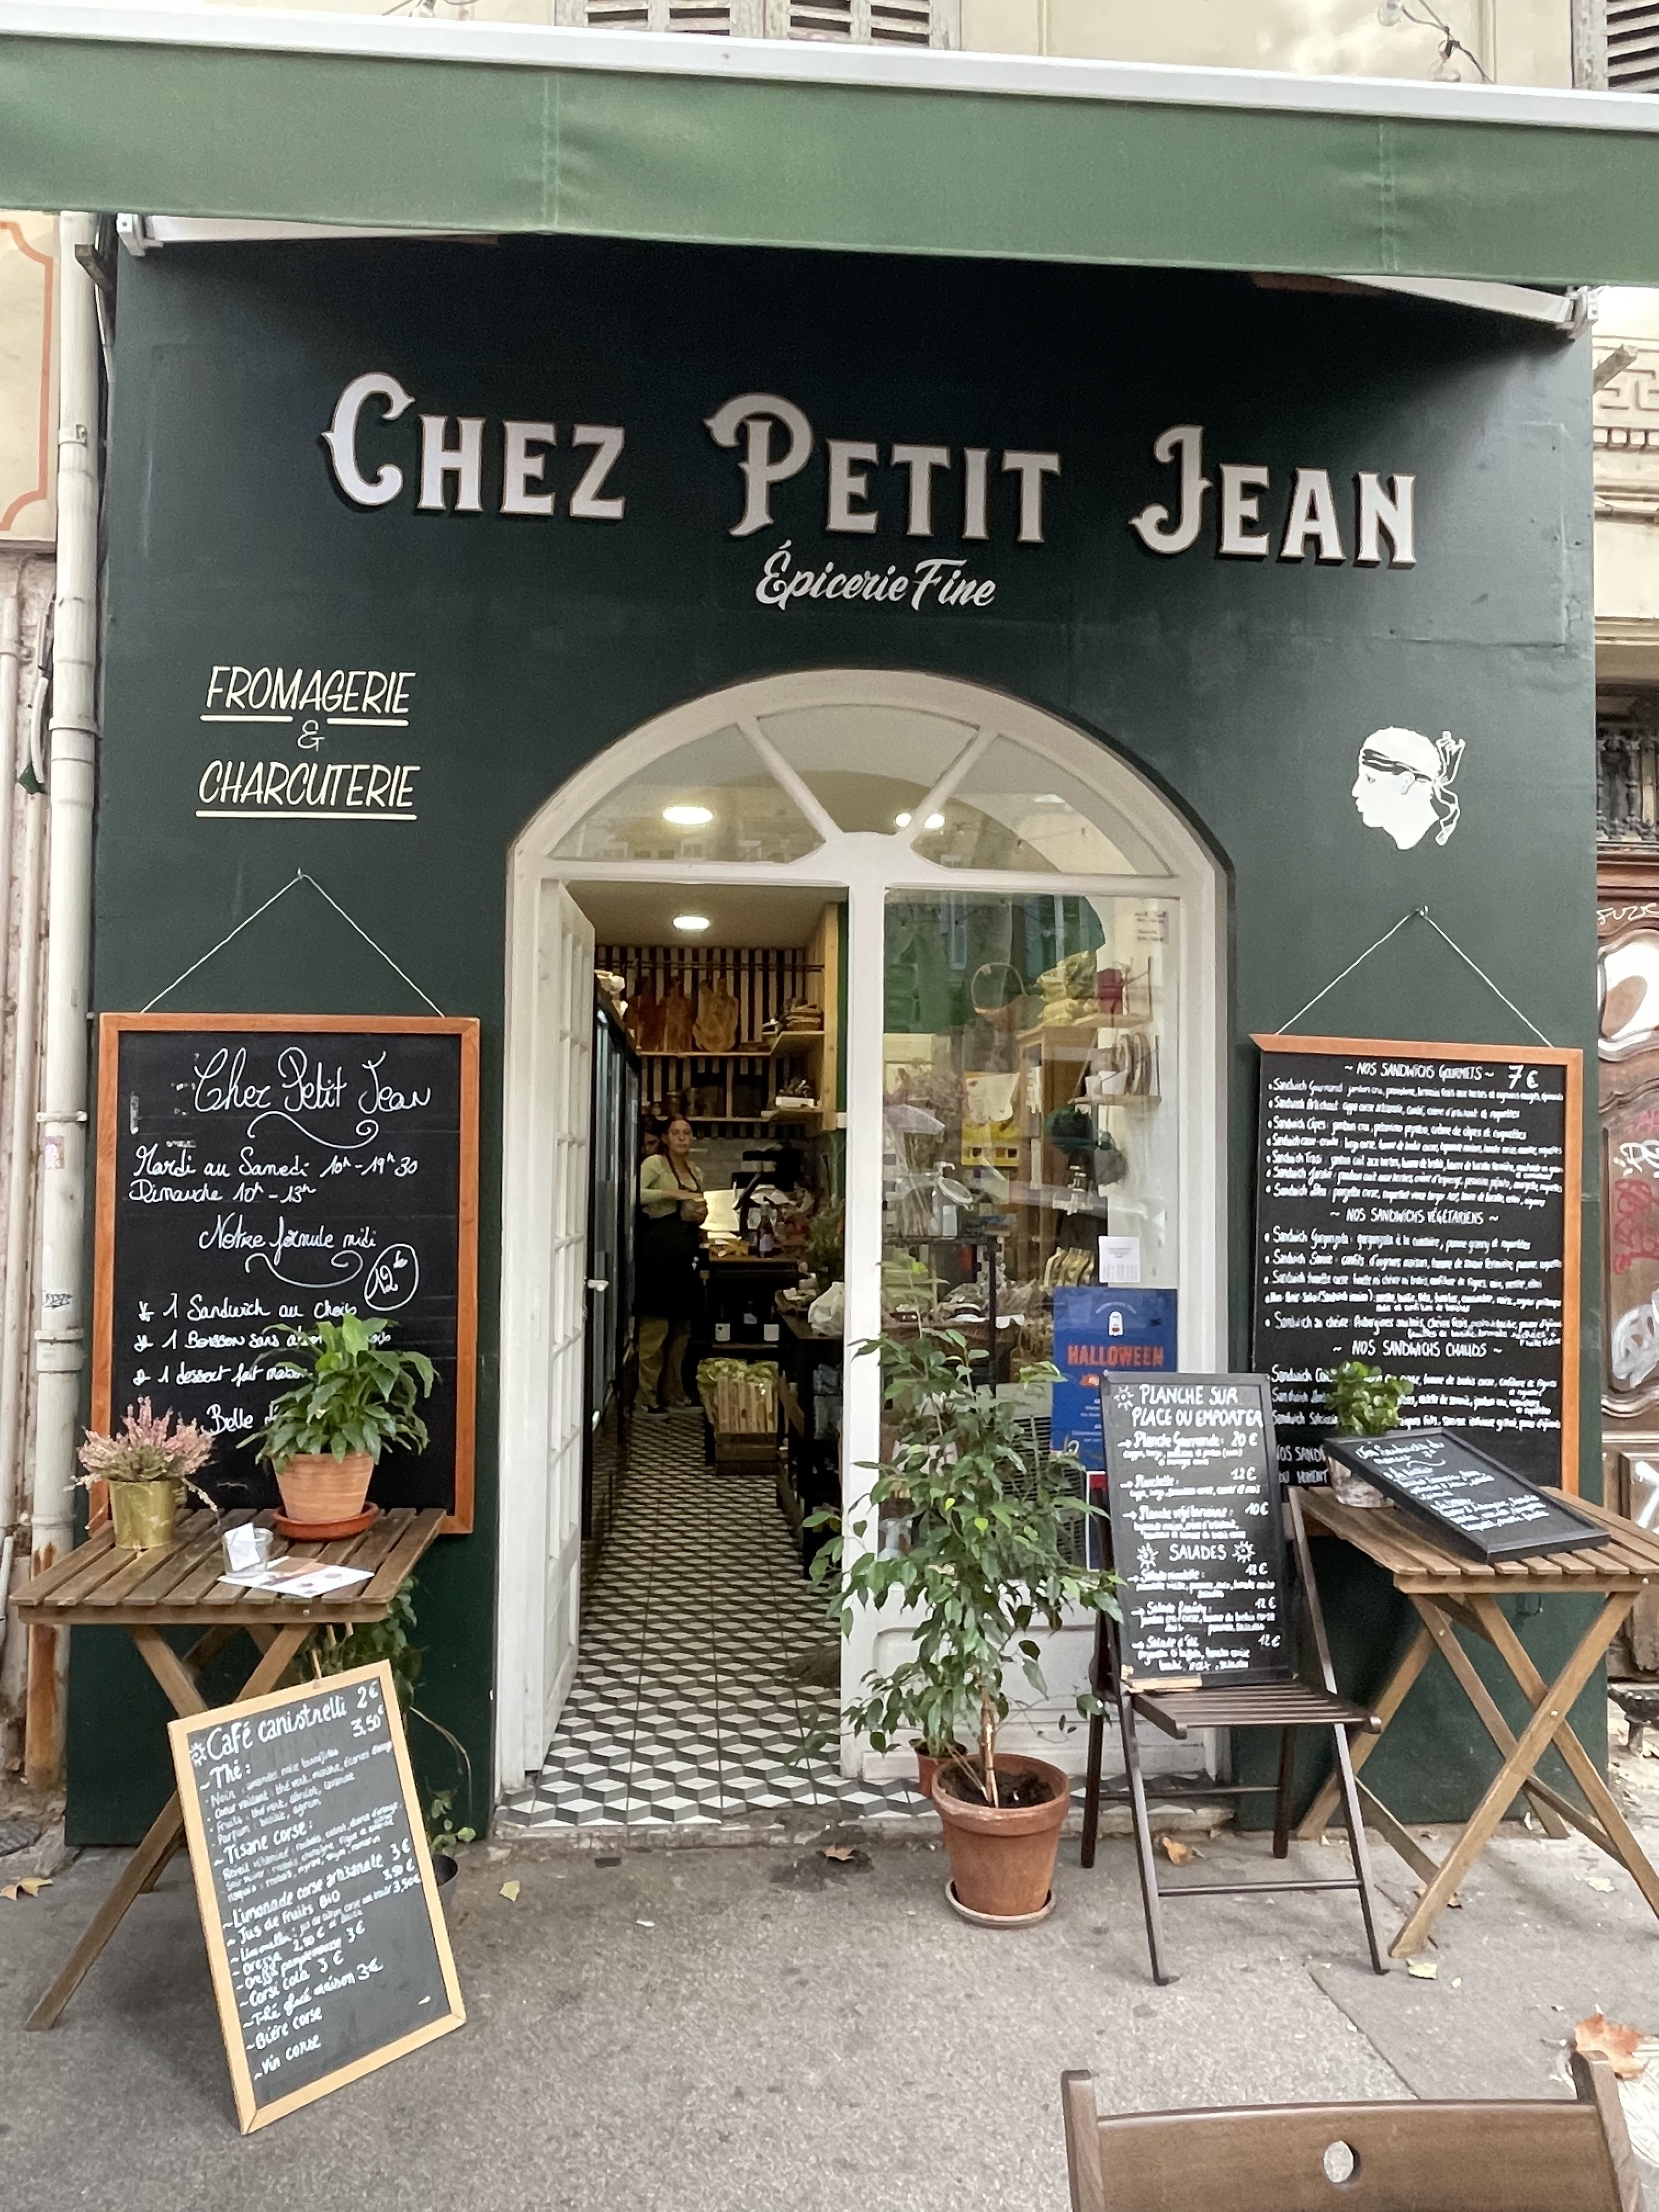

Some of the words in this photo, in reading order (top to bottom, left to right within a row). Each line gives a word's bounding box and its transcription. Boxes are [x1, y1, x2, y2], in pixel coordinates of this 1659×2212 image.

[321, 371, 626, 520] CHEZ
[703, 392, 1061, 544] PETIT
[1128, 424, 1417, 564] JEAN
[755, 540, 909, 610] Épicerie
[911, 558, 996, 610] Fine
[206, 665, 416, 714] FROMAGERIE
[297, 719, 325, 752] &
[199, 760, 421, 808] CHARCUTERIE
[194, 1048, 271, 1113] Chez
[278, 1047, 347, 1113] Petit
[358, 1050, 431, 1114] Jean
[133, 1143, 196, 1177] Mardi
[204, 1163, 231, 1177] au
[238, 1146, 309, 1176] Samedi
[128, 1179, 223, 1203] Dimanche
[187, 1294, 272, 1321] Sandwich
[279, 1305, 305, 1318] au
[1068, 1344, 1165, 1368] HALLOWEEN
[1139, 1384, 1205, 1405] PLANCHE
[200, 1403, 253, 1436] Belle
[1132, 1407, 1172, 1427] PLACE
[1175, 1410, 1192, 1426] OU
[1169, 1543, 1227, 1561] SALADES
